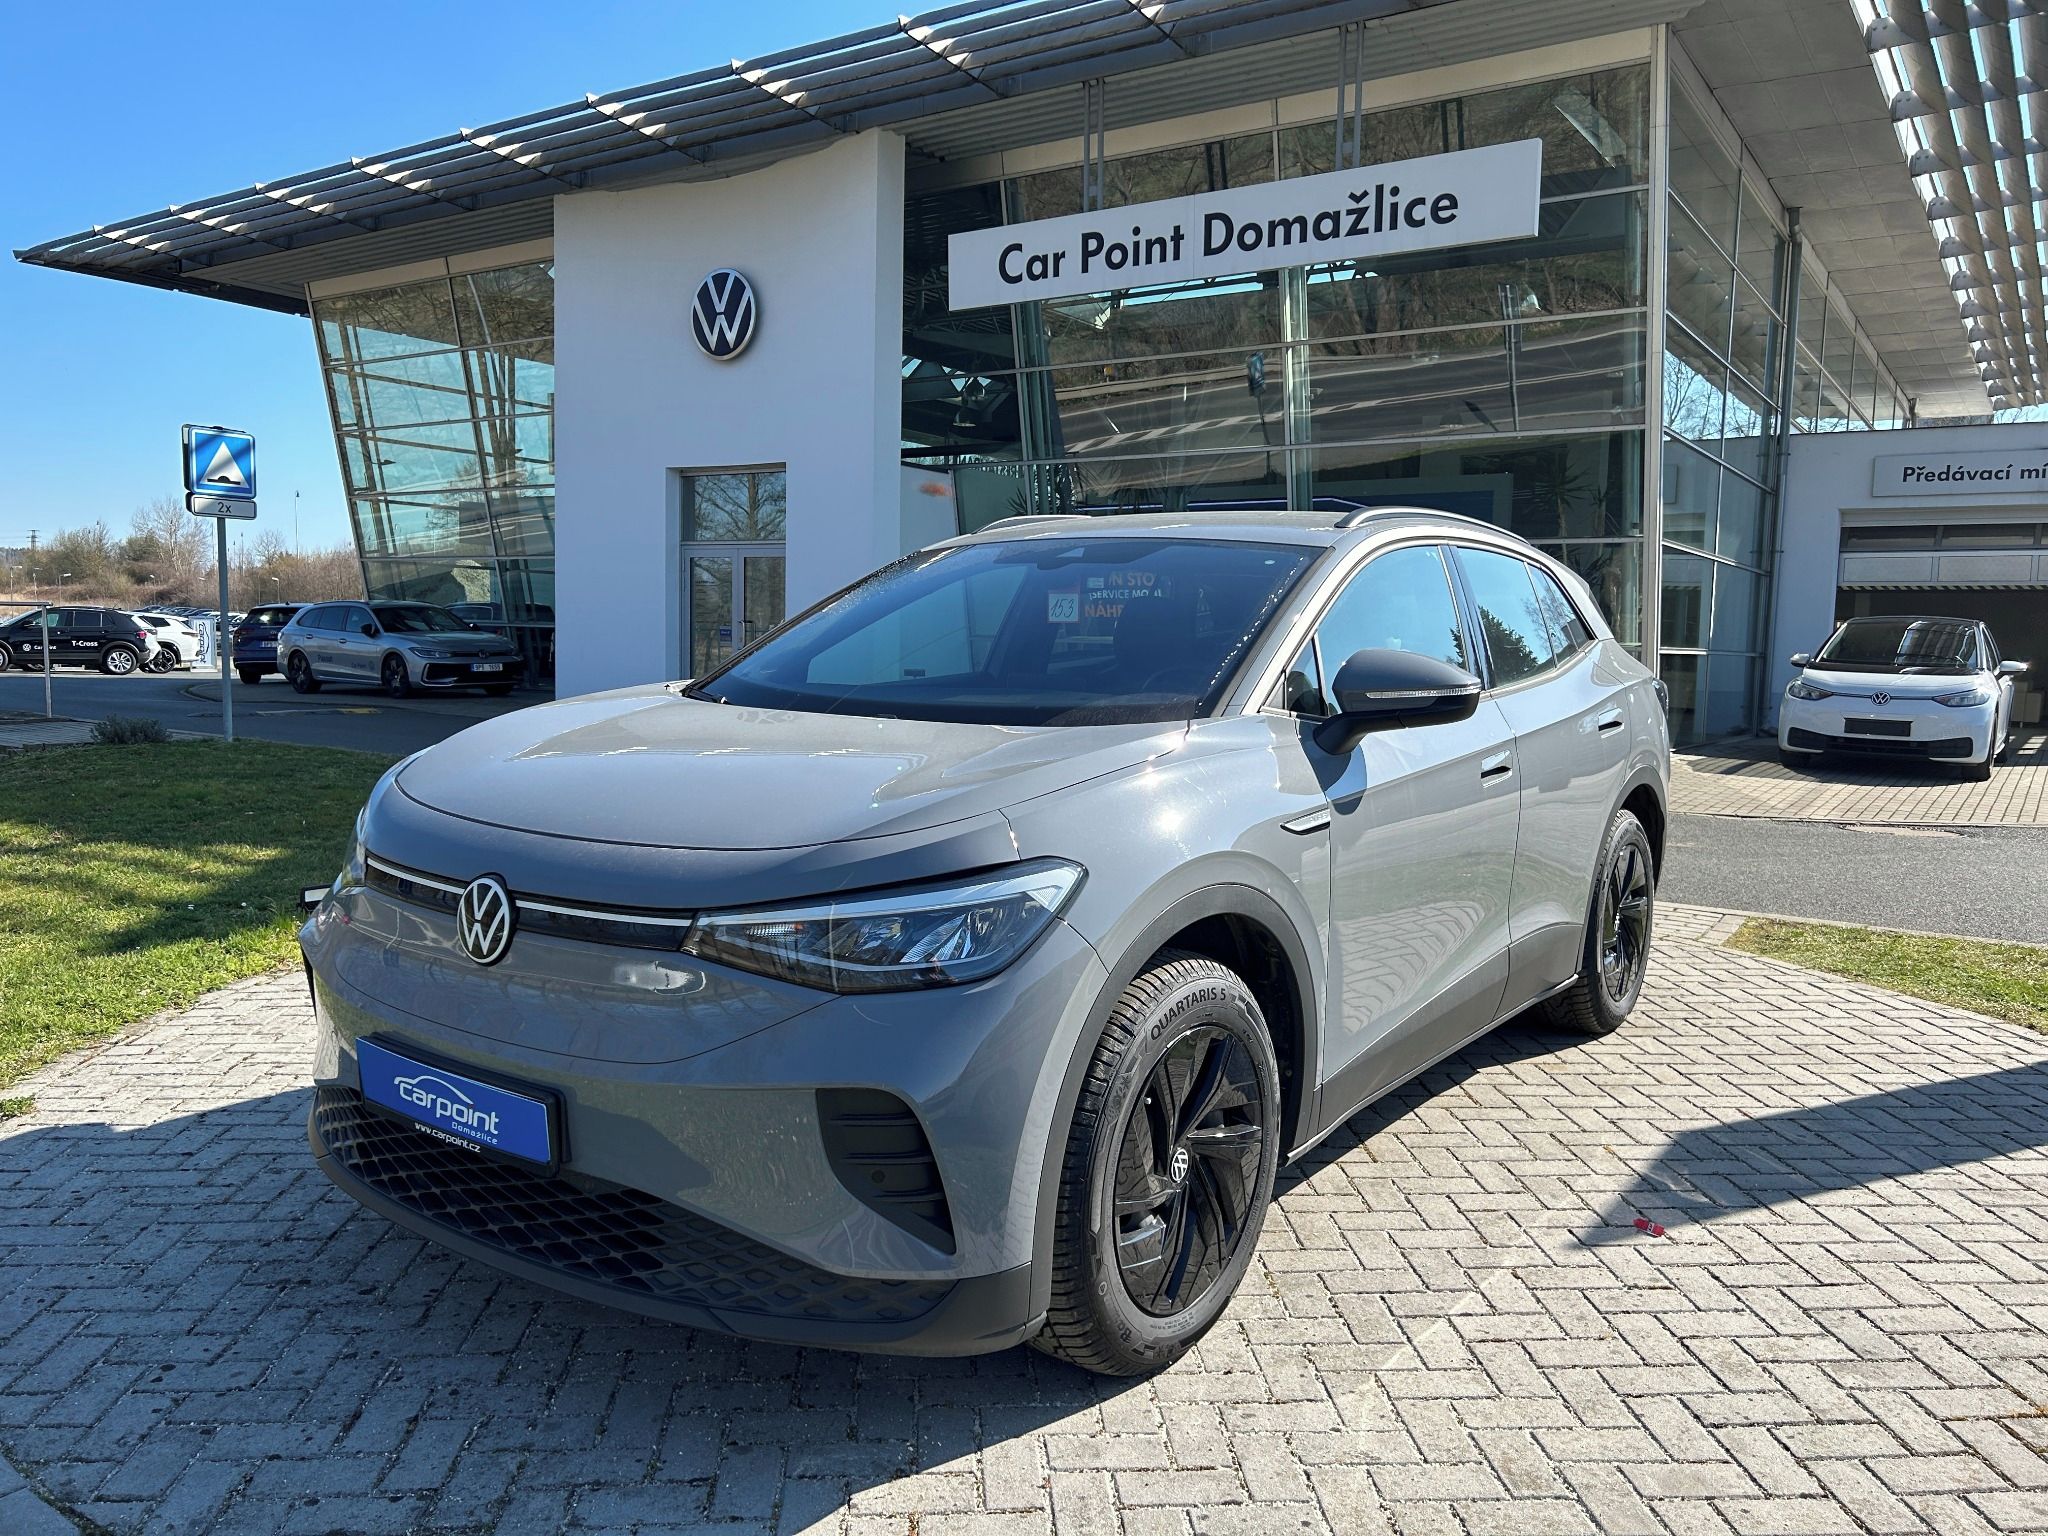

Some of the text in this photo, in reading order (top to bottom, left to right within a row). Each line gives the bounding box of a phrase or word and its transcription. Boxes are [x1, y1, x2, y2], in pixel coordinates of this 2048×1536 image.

[999, 184, 1459, 285] Car Point Domažlice
[1902, 464, 2014, 483] Předávací
[217, 502, 232, 513] 2x
[1050, 598, 1075, 619] 153
[1150, 987, 1218, 1041] QUARTARIS
[1220, 988, 1227, 1001] 5
[399, 1082, 500, 1135] carpoint
[414, 1122, 481, 1153] www.carpoint.cz
